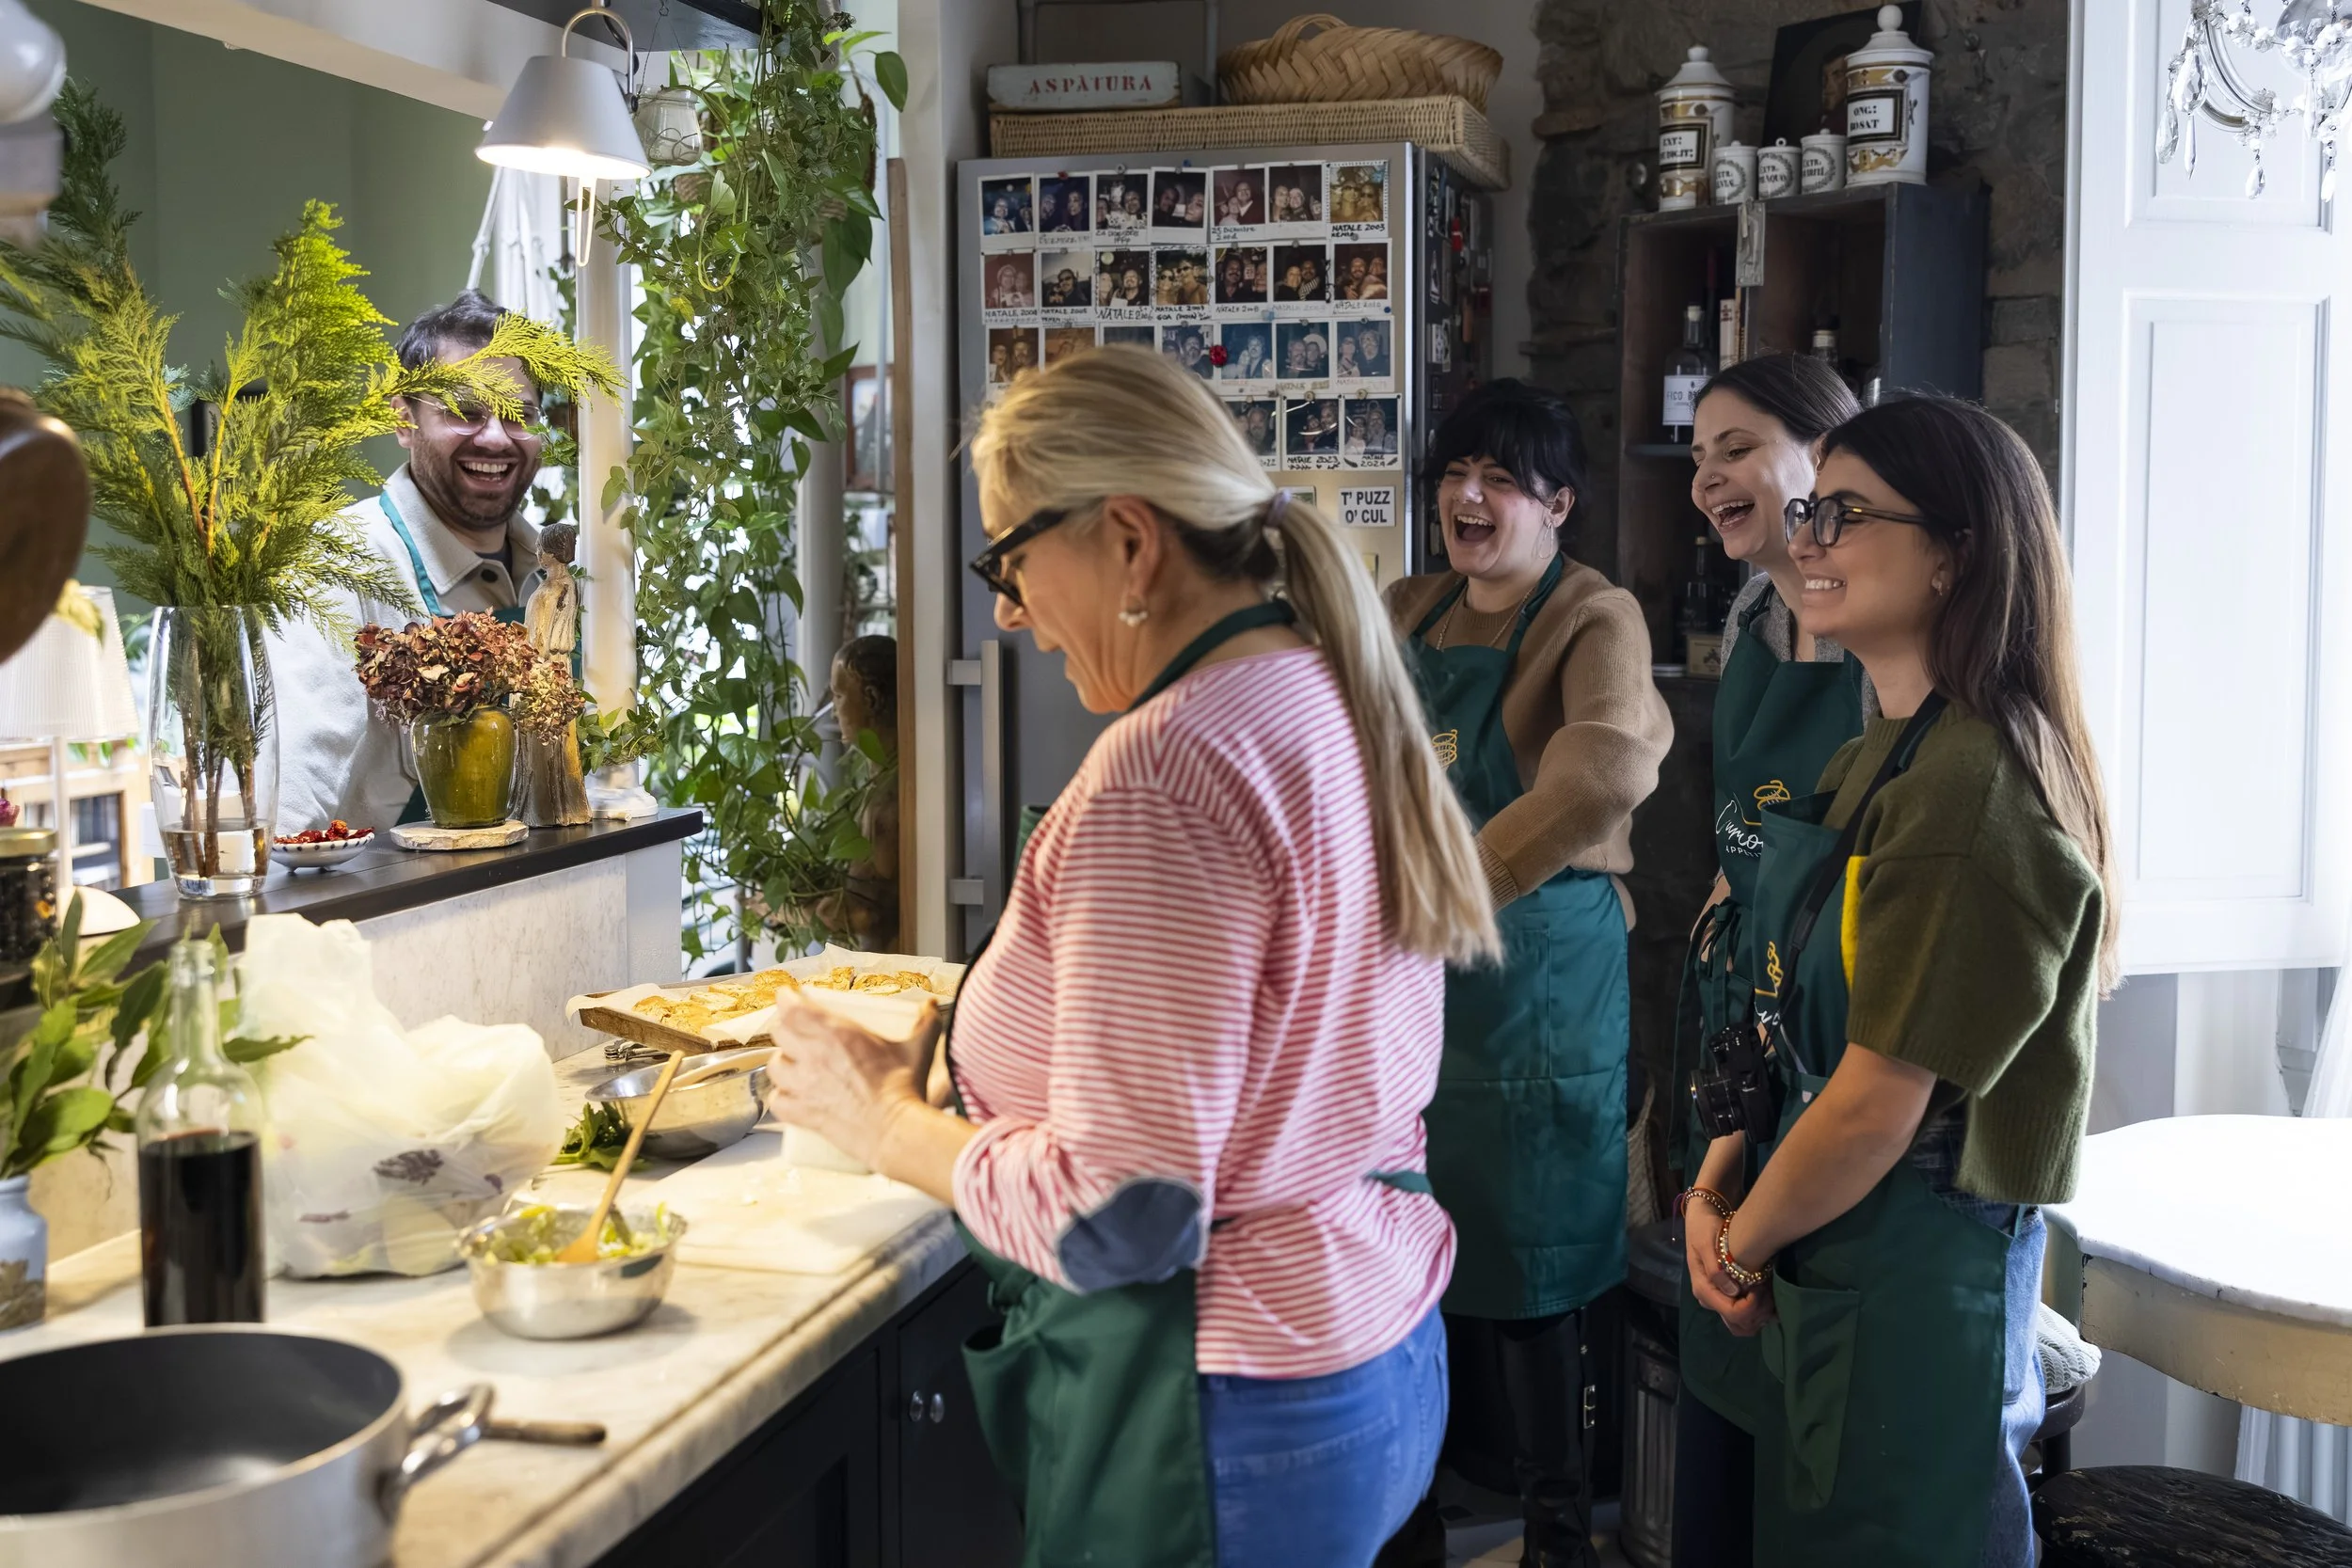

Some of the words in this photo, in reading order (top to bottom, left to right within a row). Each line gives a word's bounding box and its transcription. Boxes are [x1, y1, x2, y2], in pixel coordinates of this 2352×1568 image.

[1332, 224, 1362, 232] NATALE
[985, 309, 1018, 318] NATALE
[1097, 308, 1135, 321] NATALE
[1357, 491, 1391, 505] PUZZ
[1361, 509, 1388, 524] CUL
